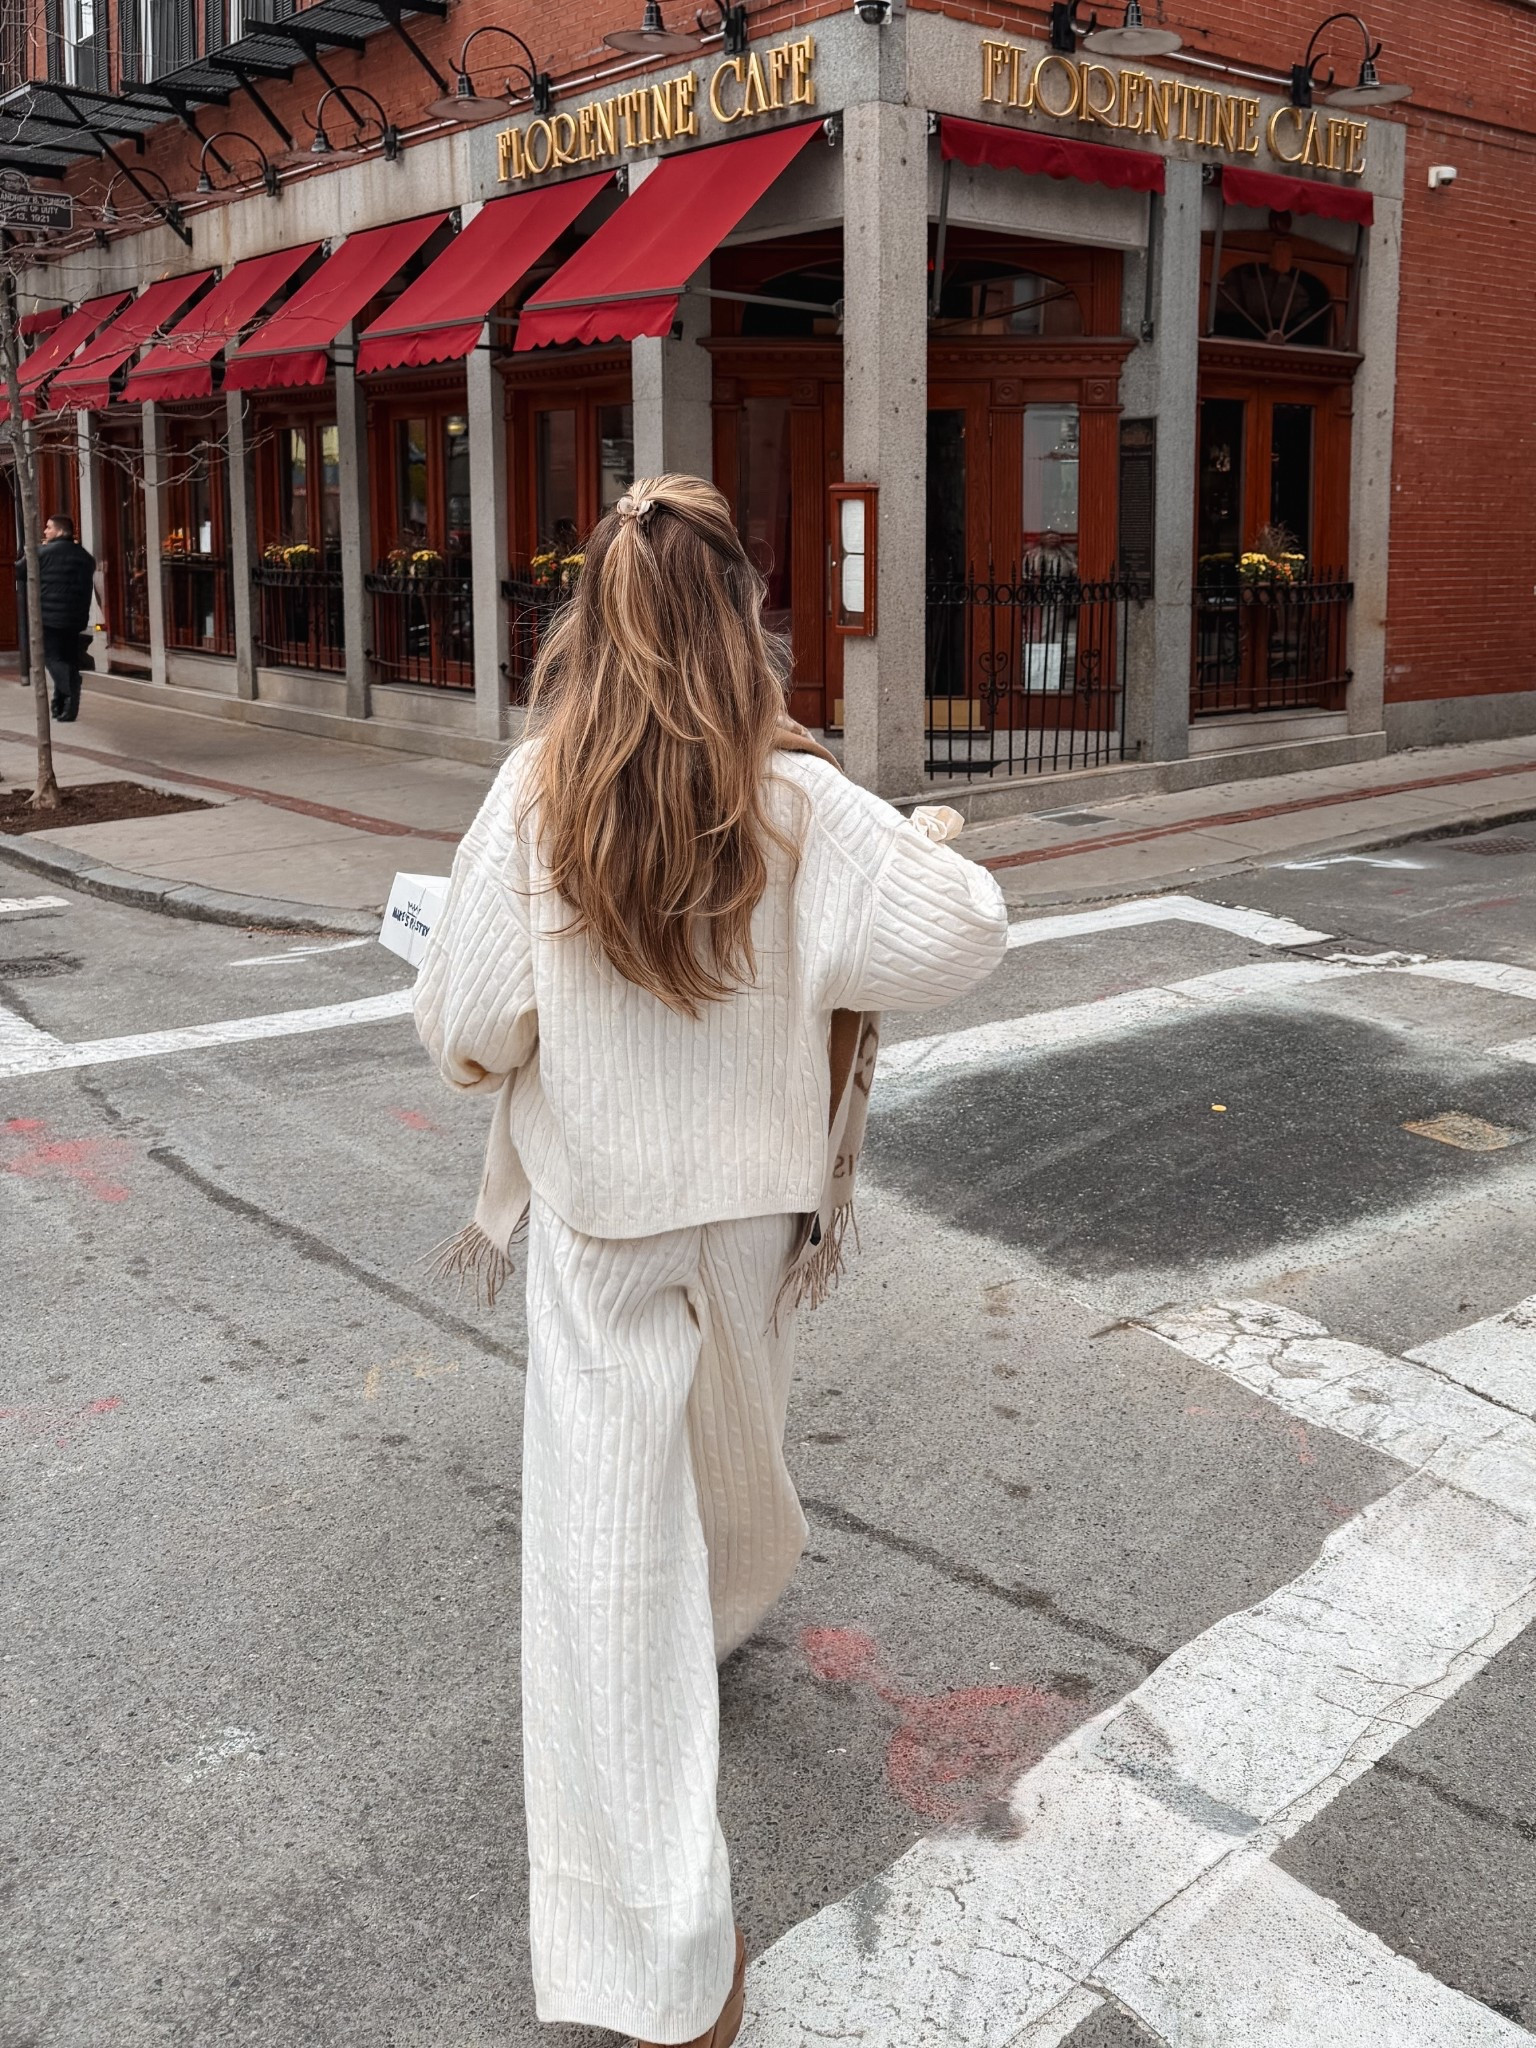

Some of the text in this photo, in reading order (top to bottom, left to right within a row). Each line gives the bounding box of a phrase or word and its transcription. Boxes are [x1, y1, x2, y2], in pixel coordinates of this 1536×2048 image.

[496, 35, 816, 183] FLORENTINE CAFE
[981, 40, 1369, 178] FLORENTINE CAFE
[31, 213, 50, 223] 1921
[40, 206, 58, 215] DUTY
